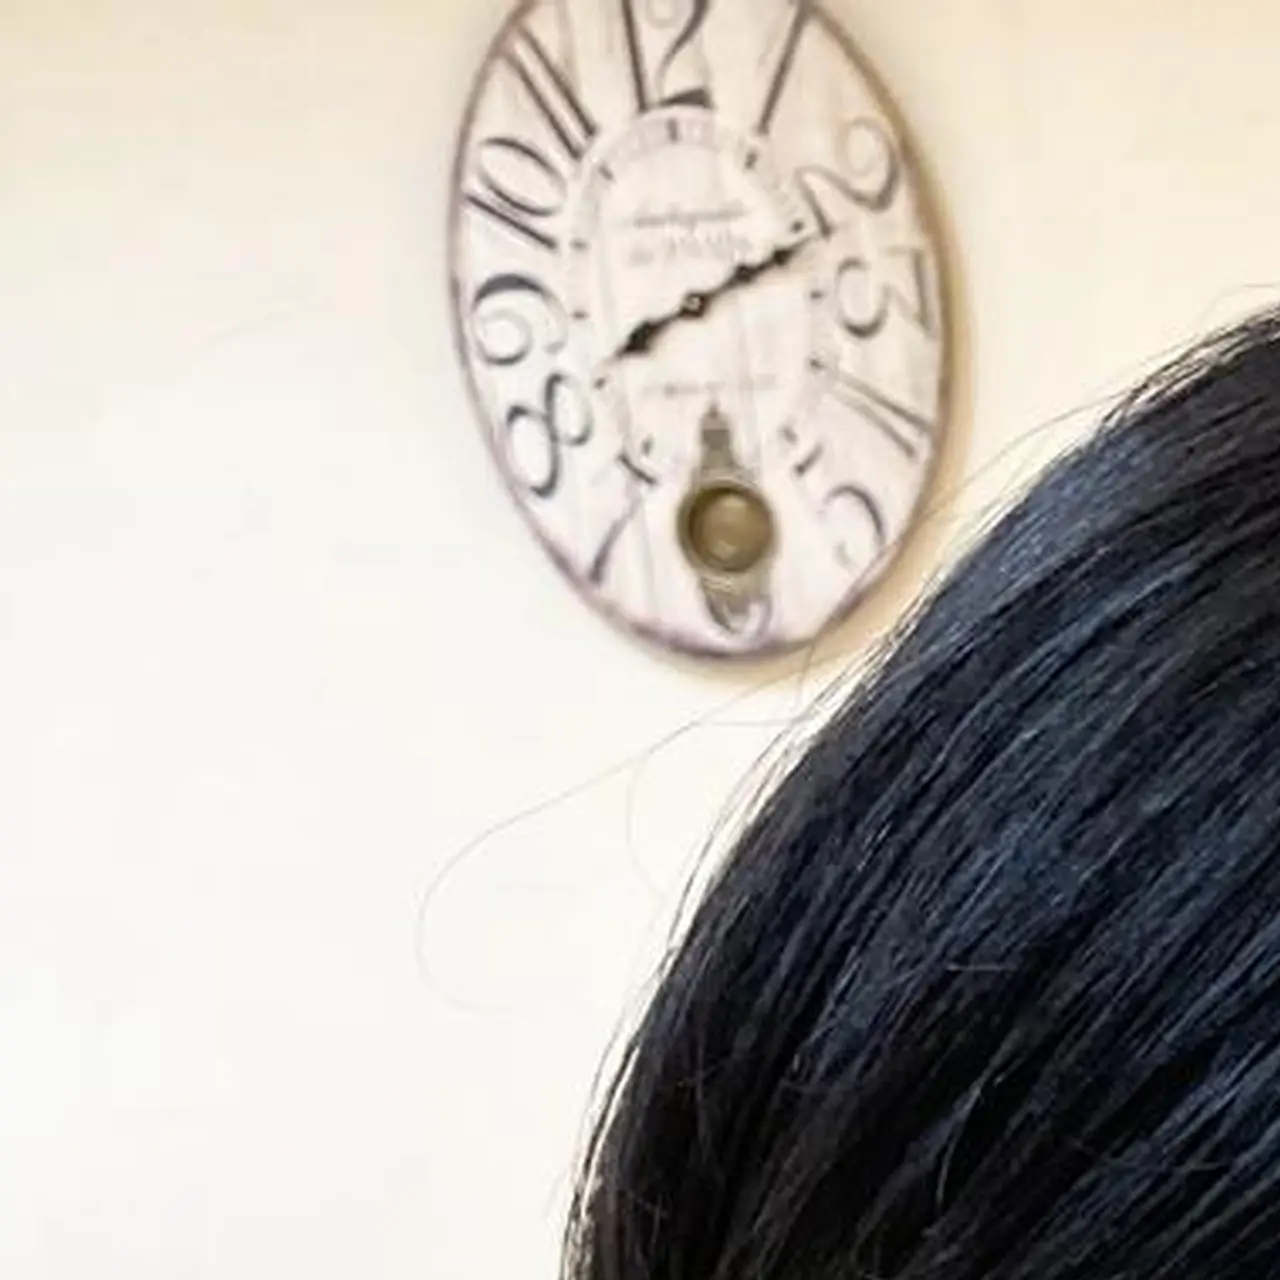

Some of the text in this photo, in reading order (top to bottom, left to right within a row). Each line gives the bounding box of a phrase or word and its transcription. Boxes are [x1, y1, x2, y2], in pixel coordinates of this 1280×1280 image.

[466, 136, 569, 250] 10
[797, 116, 900, 239] 2
[470, 272, 569, 367] 9
[835, 246, 938, 340] 3
[505, 369, 595, 500] 8
